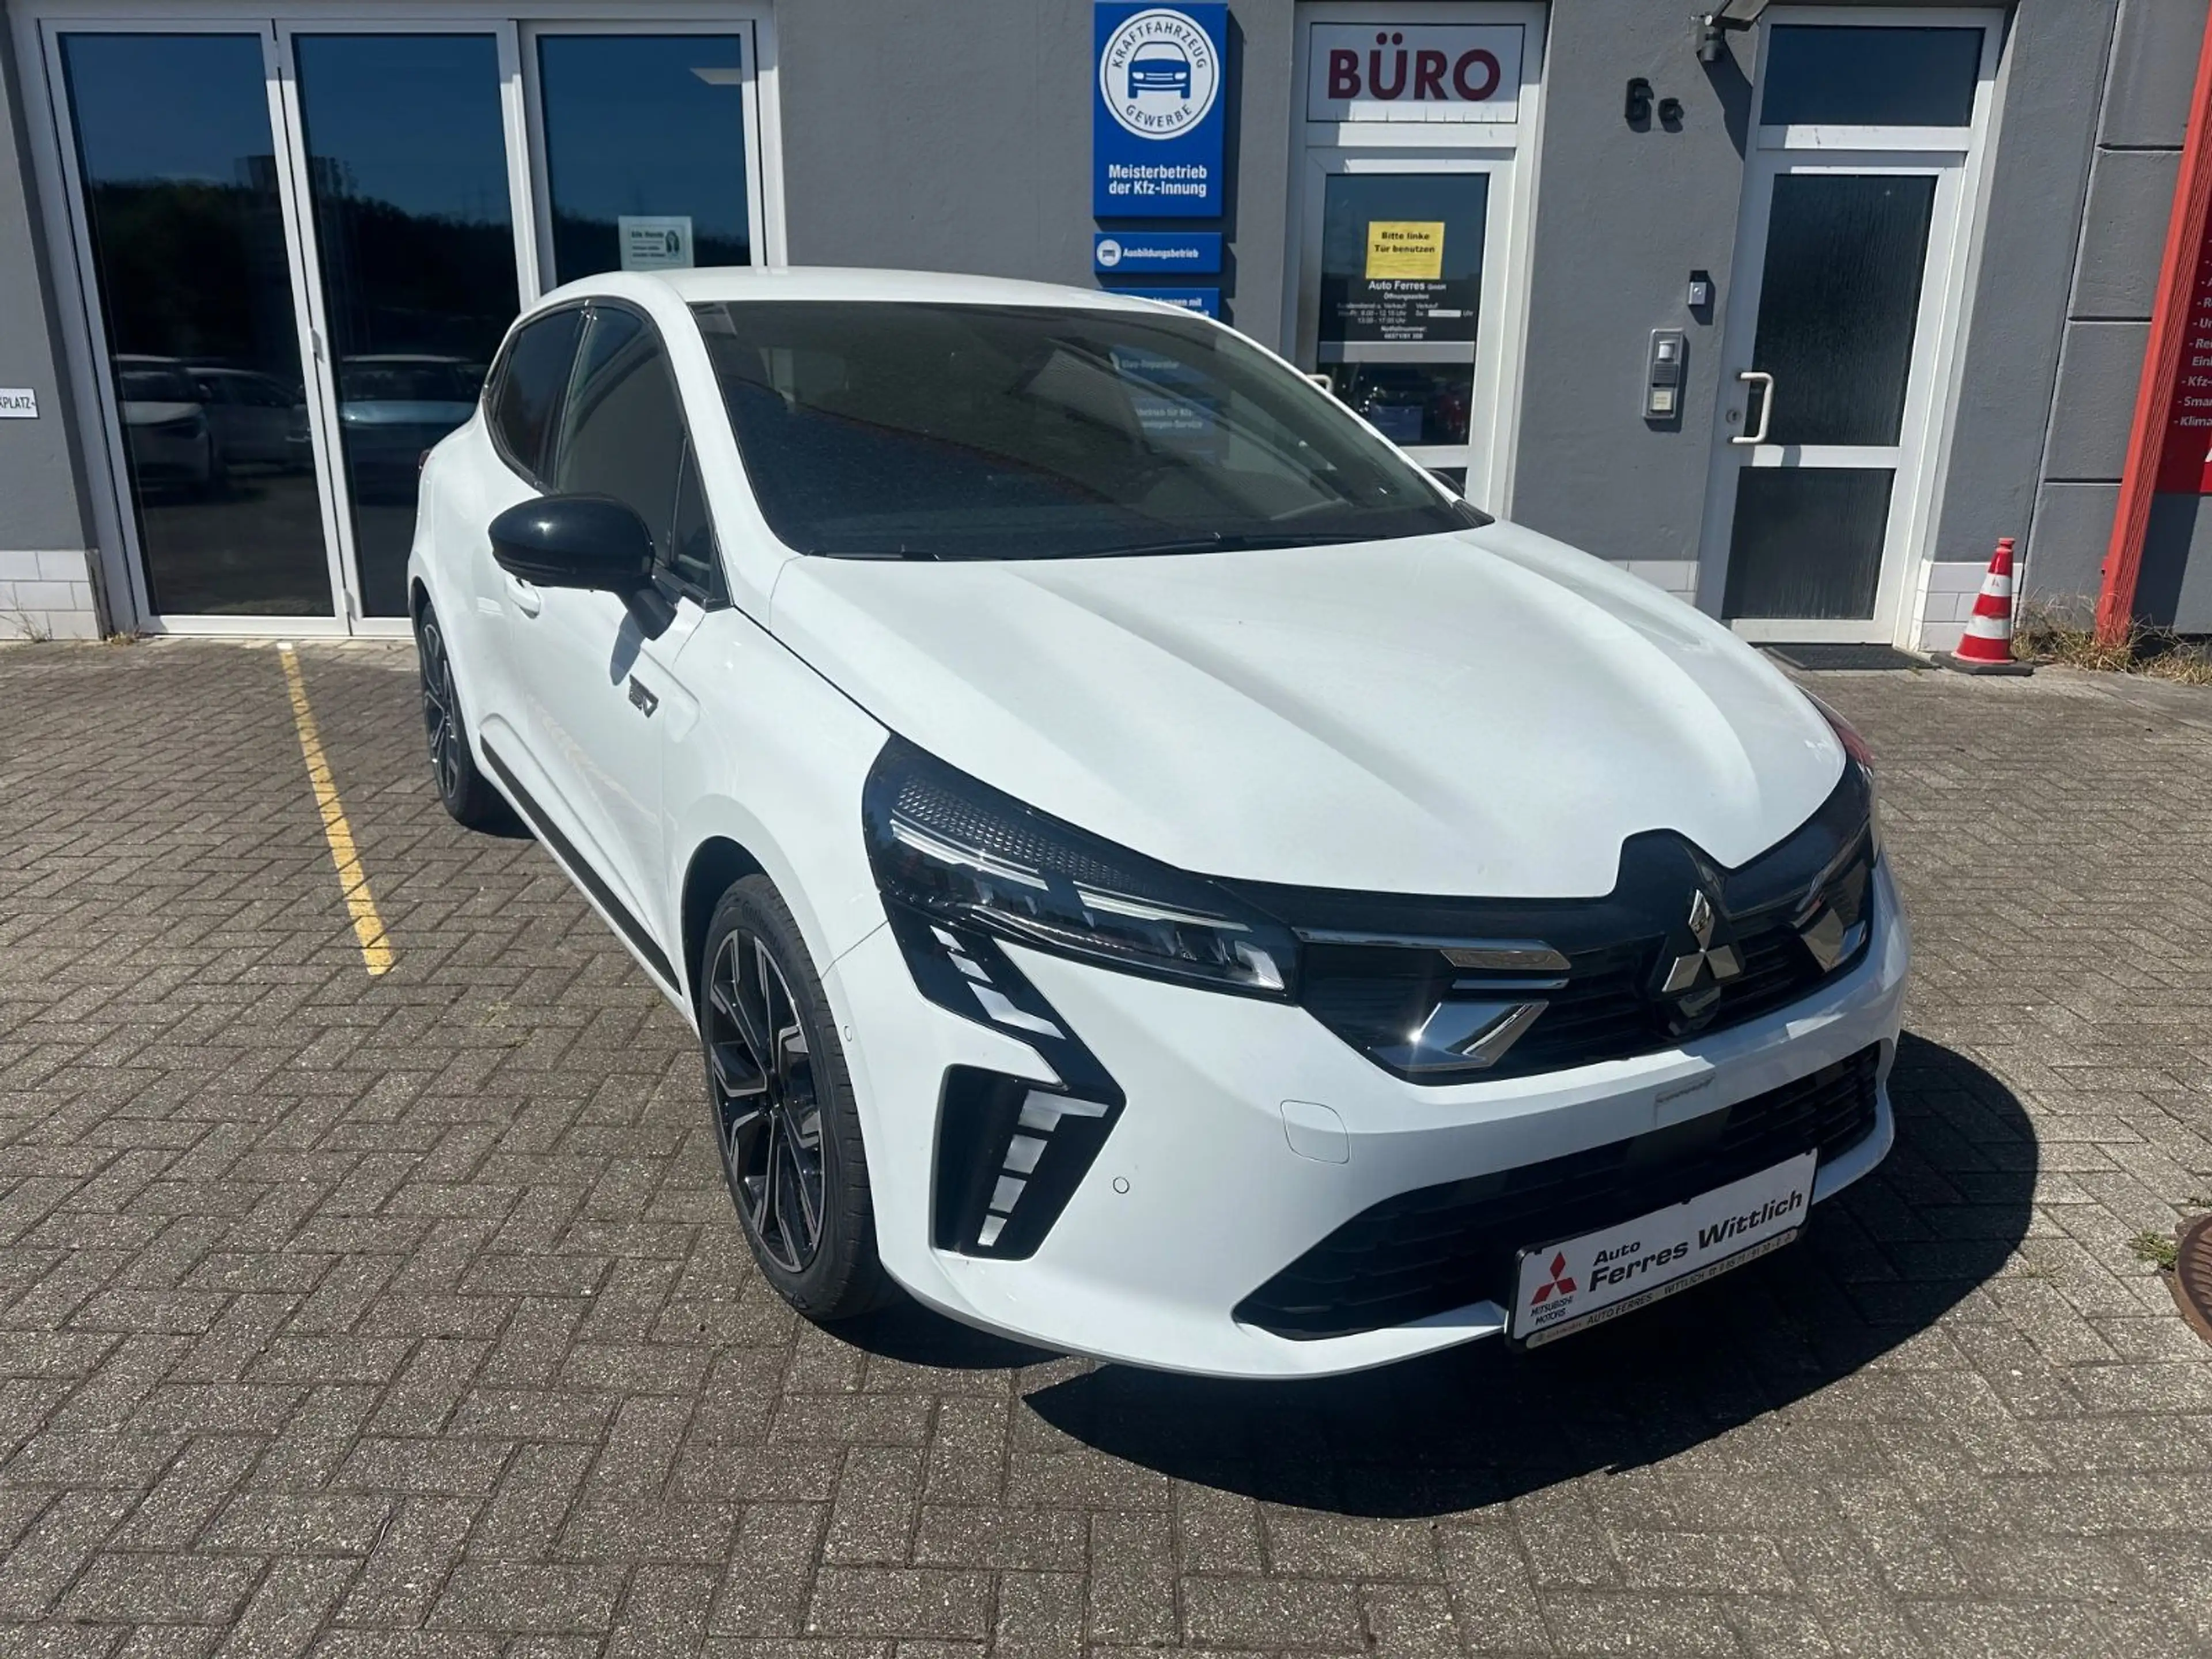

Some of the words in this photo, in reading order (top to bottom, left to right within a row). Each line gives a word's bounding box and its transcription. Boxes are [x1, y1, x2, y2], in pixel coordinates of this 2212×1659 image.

[1112, 21, 1207, 69] KRAFTFAHRZEUG
[1328, 32, 1501, 101] BÜRO
[1126, 104, 1192, 127] GEWERBE
[1108, 164, 1207, 179] Meisterbetrieb
[1108, 181, 1131, 194] der
[1133, 180, 1207, 197] Kfz-Innung
[1123, 248, 1199, 259] Ausbildungsbetrieb
[1368, 281, 1392, 290] Auto
[1394, 281, 1425, 290] Ferres
[1589, 1241, 1689, 1292] Ferres
[1699, 1190, 1803, 1250] Wittlich
[1593, 1241, 1641, 1267] Auto
[1530, 1296, 1573, 1317] MITSUBISHI
[1587, 1308, 1613, 1325] AUTO
[1615, 1292, 1652, 1315] FERRES
[1664, 1272, 1705, 1295] WITTLICH
[1535, 1308, 1566, 1325] MOTORS
